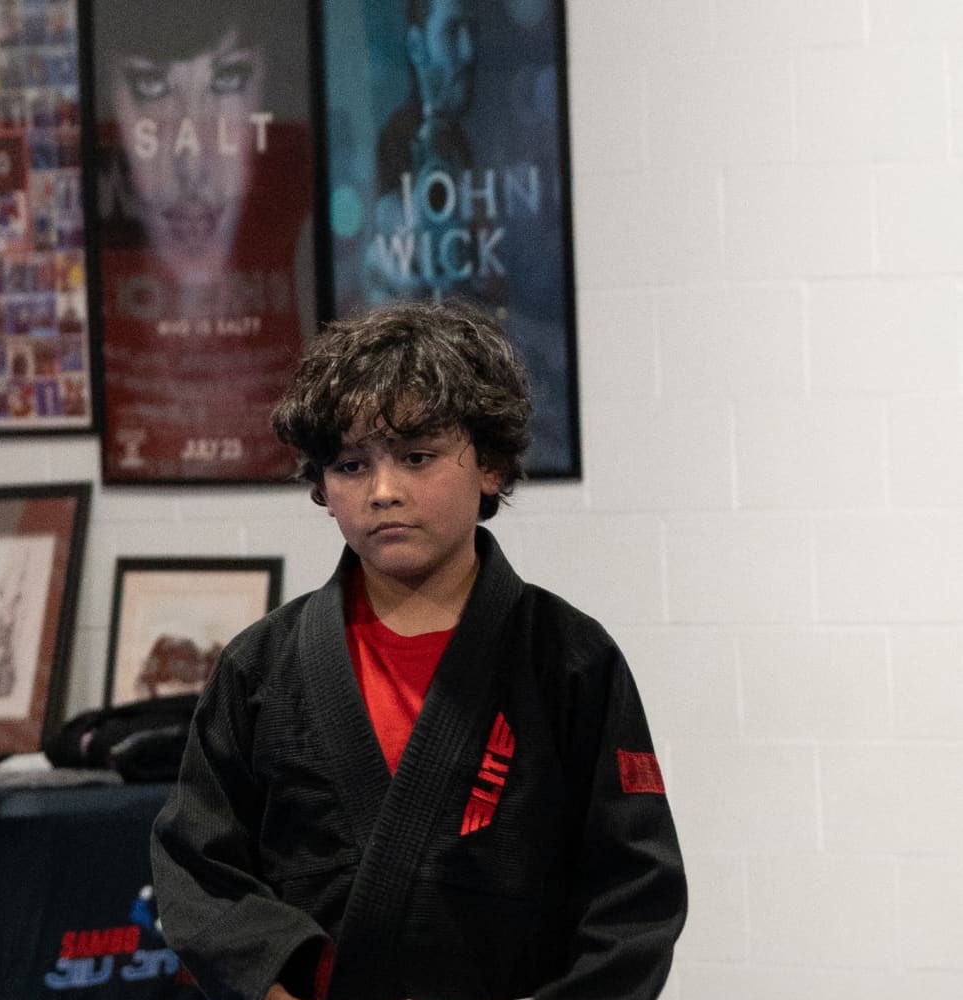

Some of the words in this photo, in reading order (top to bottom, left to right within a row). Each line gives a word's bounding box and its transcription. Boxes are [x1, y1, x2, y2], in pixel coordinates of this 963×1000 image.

[135, 112, 273, 158] SALT
[398, 166, 540, 232] JOHN
[376, 228, 506, 281] WICK
[460, 711, 516, 836] ELITE
[60, 924, 140, 959] SAMBO
